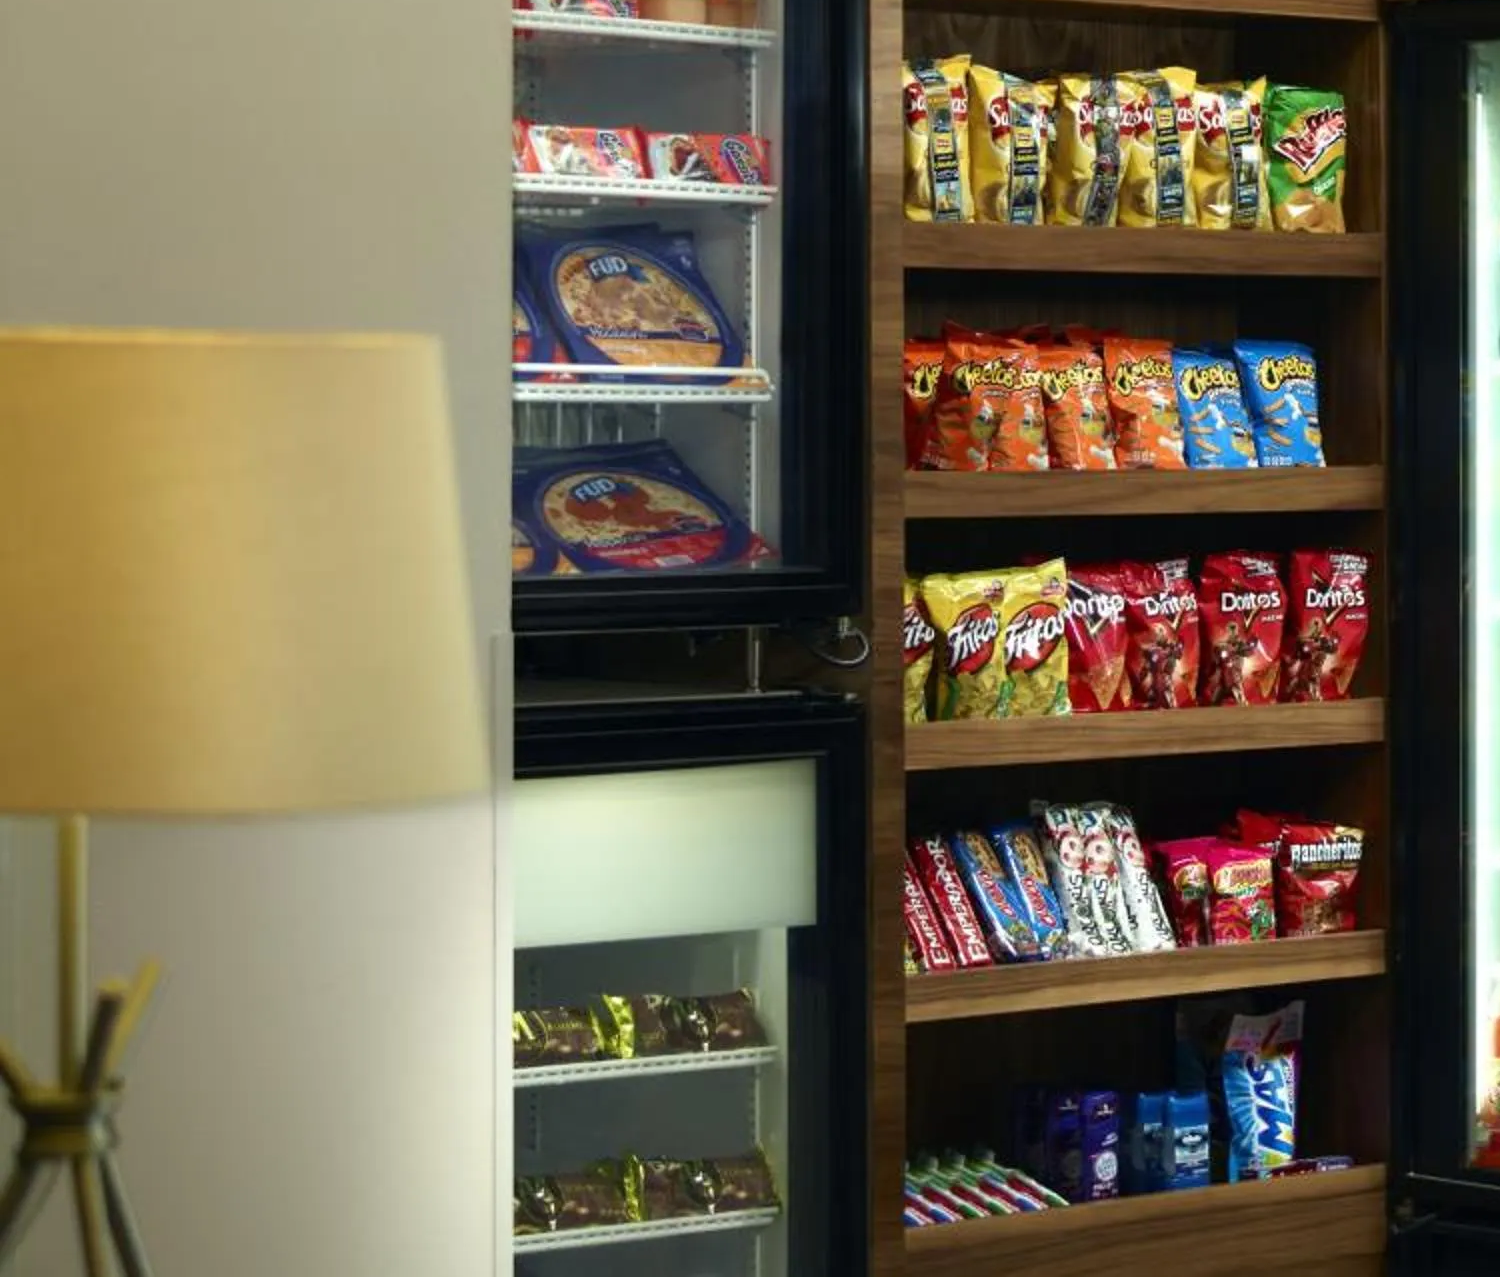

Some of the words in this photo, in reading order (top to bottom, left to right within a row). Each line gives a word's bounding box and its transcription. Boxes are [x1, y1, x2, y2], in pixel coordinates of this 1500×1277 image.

[589, 256, 628, 278] FUD
[1260, 355, 1315, 391] Cheetos
[575, 478, 615, 502] FUD
[1221, 591, 1281, 612] Doritos
[1306, 587, 1364, 608] Doritos
[1004, 605, 1065, 667] Fritos
